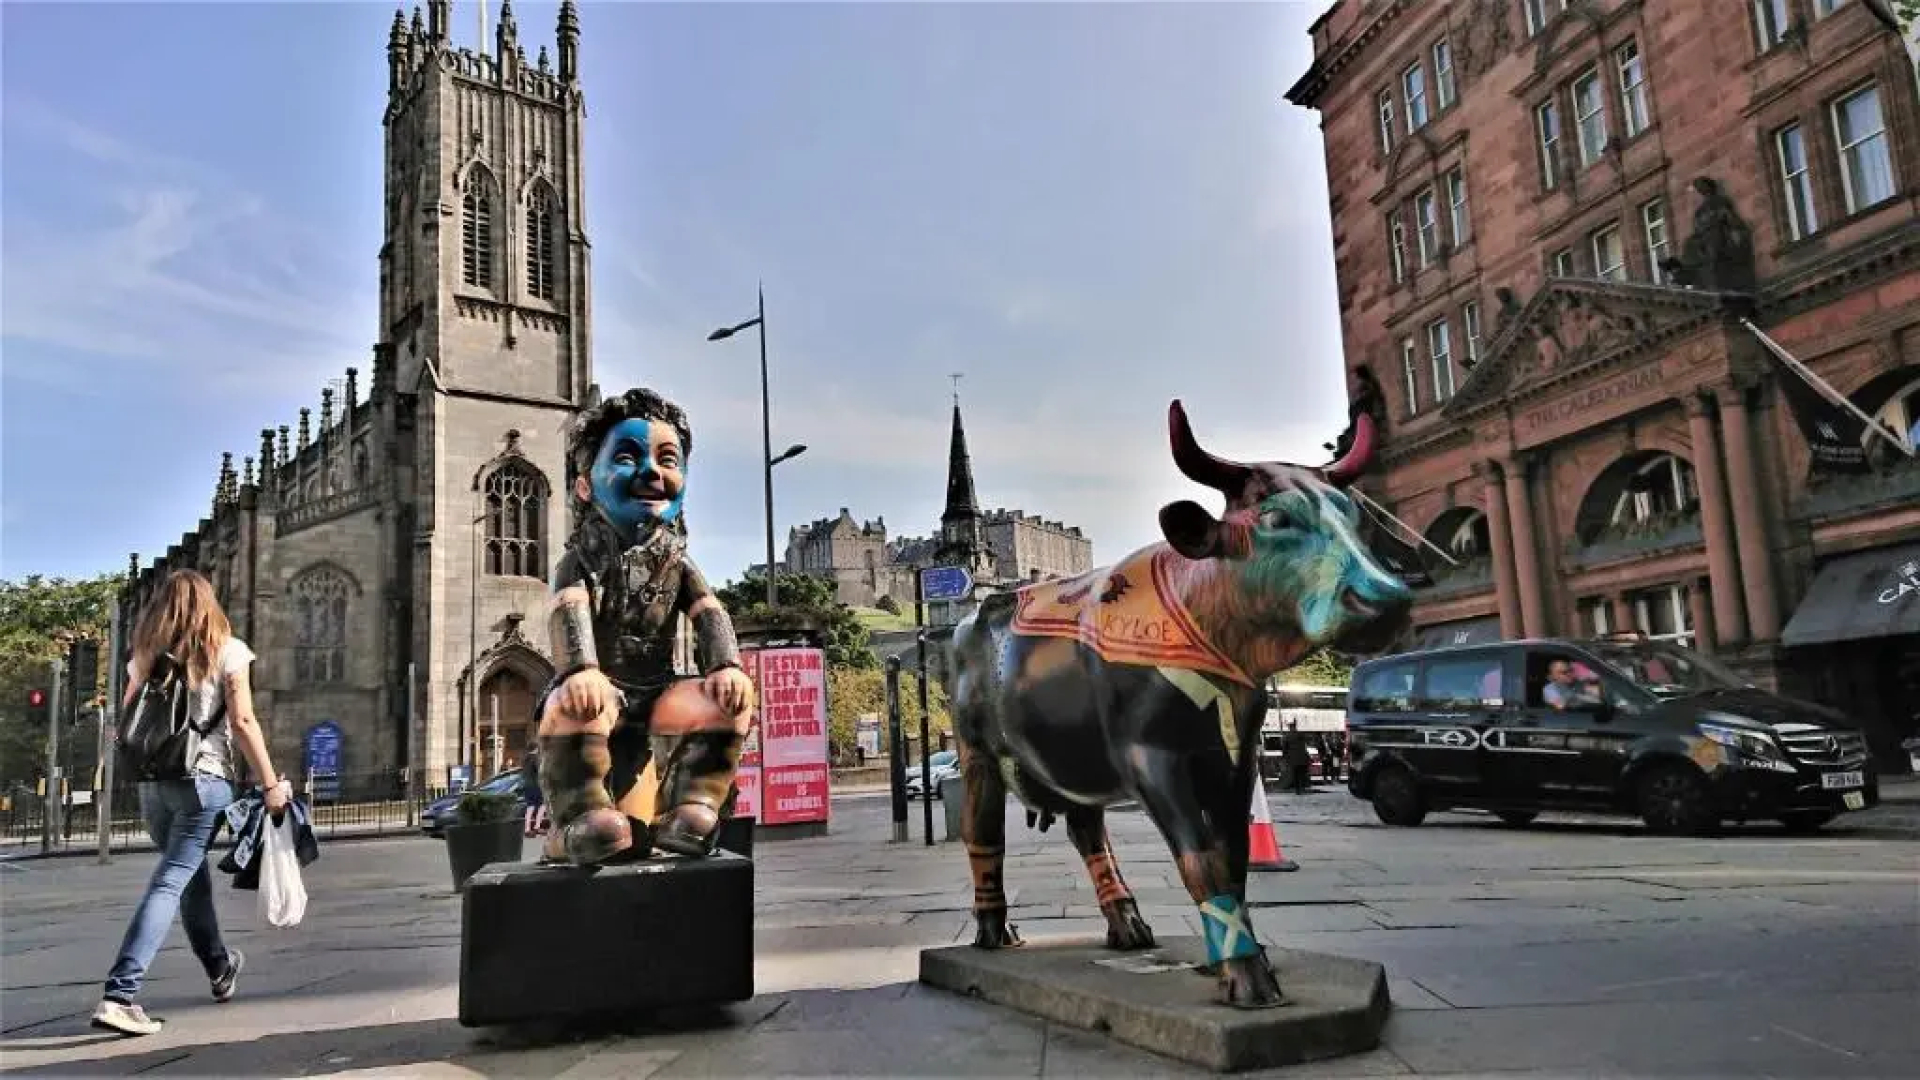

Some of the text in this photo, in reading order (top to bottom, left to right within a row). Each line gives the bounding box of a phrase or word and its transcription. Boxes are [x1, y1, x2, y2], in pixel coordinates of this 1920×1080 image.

[1103, 614, 1172, 642] KYLOE
[764, 671, 801, 688] LET'S
[764, 687, 818, 704] LOOK OUT
[766, 704, 815, 722] FOR ONE
[766, 720, 822, 739] ANOTHER
[1421, 727, 1506, 750] TAXI
